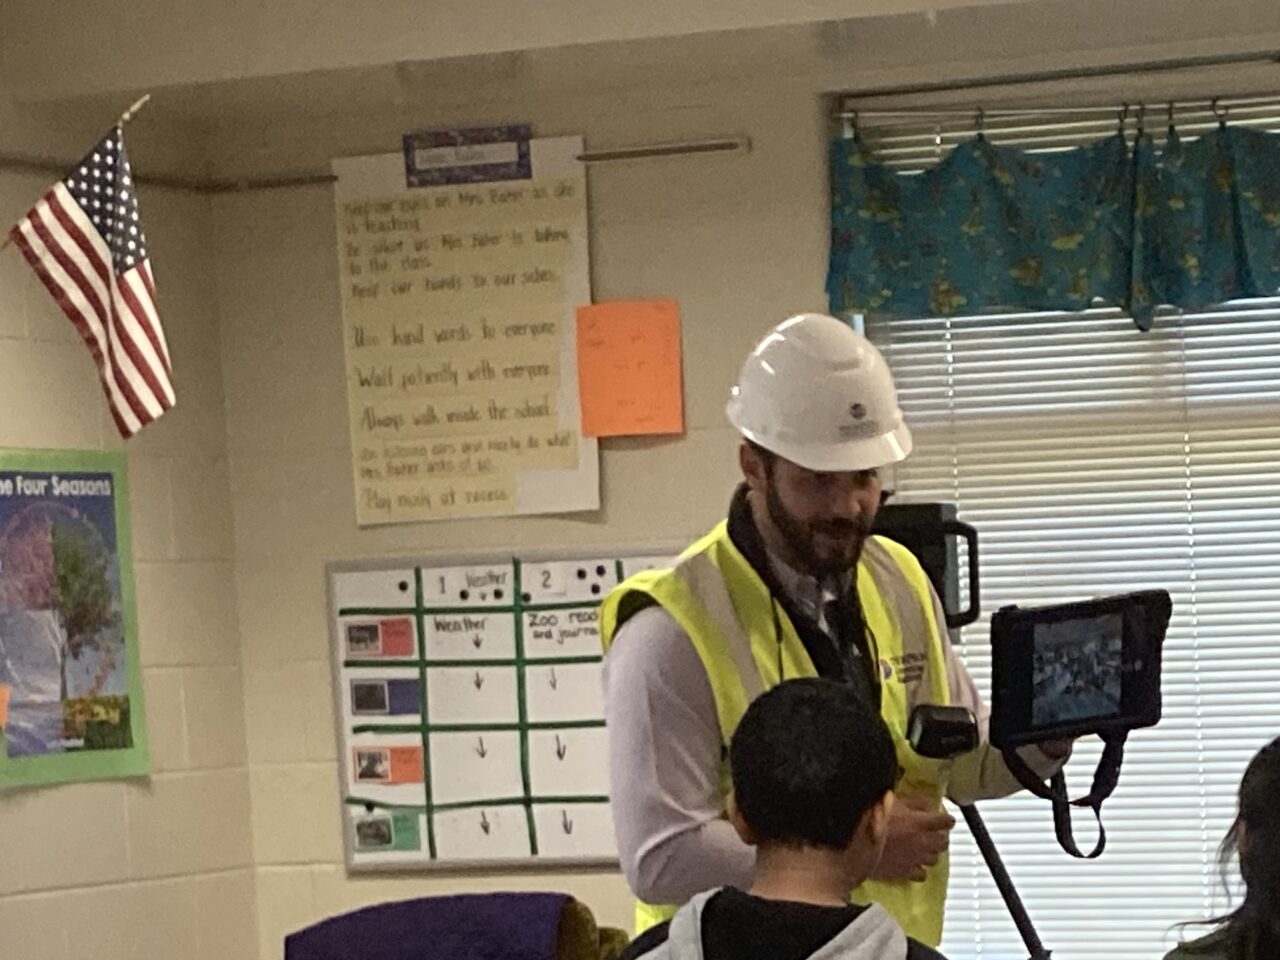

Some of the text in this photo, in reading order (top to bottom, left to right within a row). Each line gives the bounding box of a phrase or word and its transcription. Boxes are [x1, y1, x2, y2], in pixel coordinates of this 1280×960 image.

[16, 475, 49, 497] Four
[51, 475, 112, 497] Seasons
[541, 570, 553, 590] 2
[434, 616, 489, 634] Weather
[528, 613, 559, 629] Zoo
[532, 624, 600, 645] and journa
